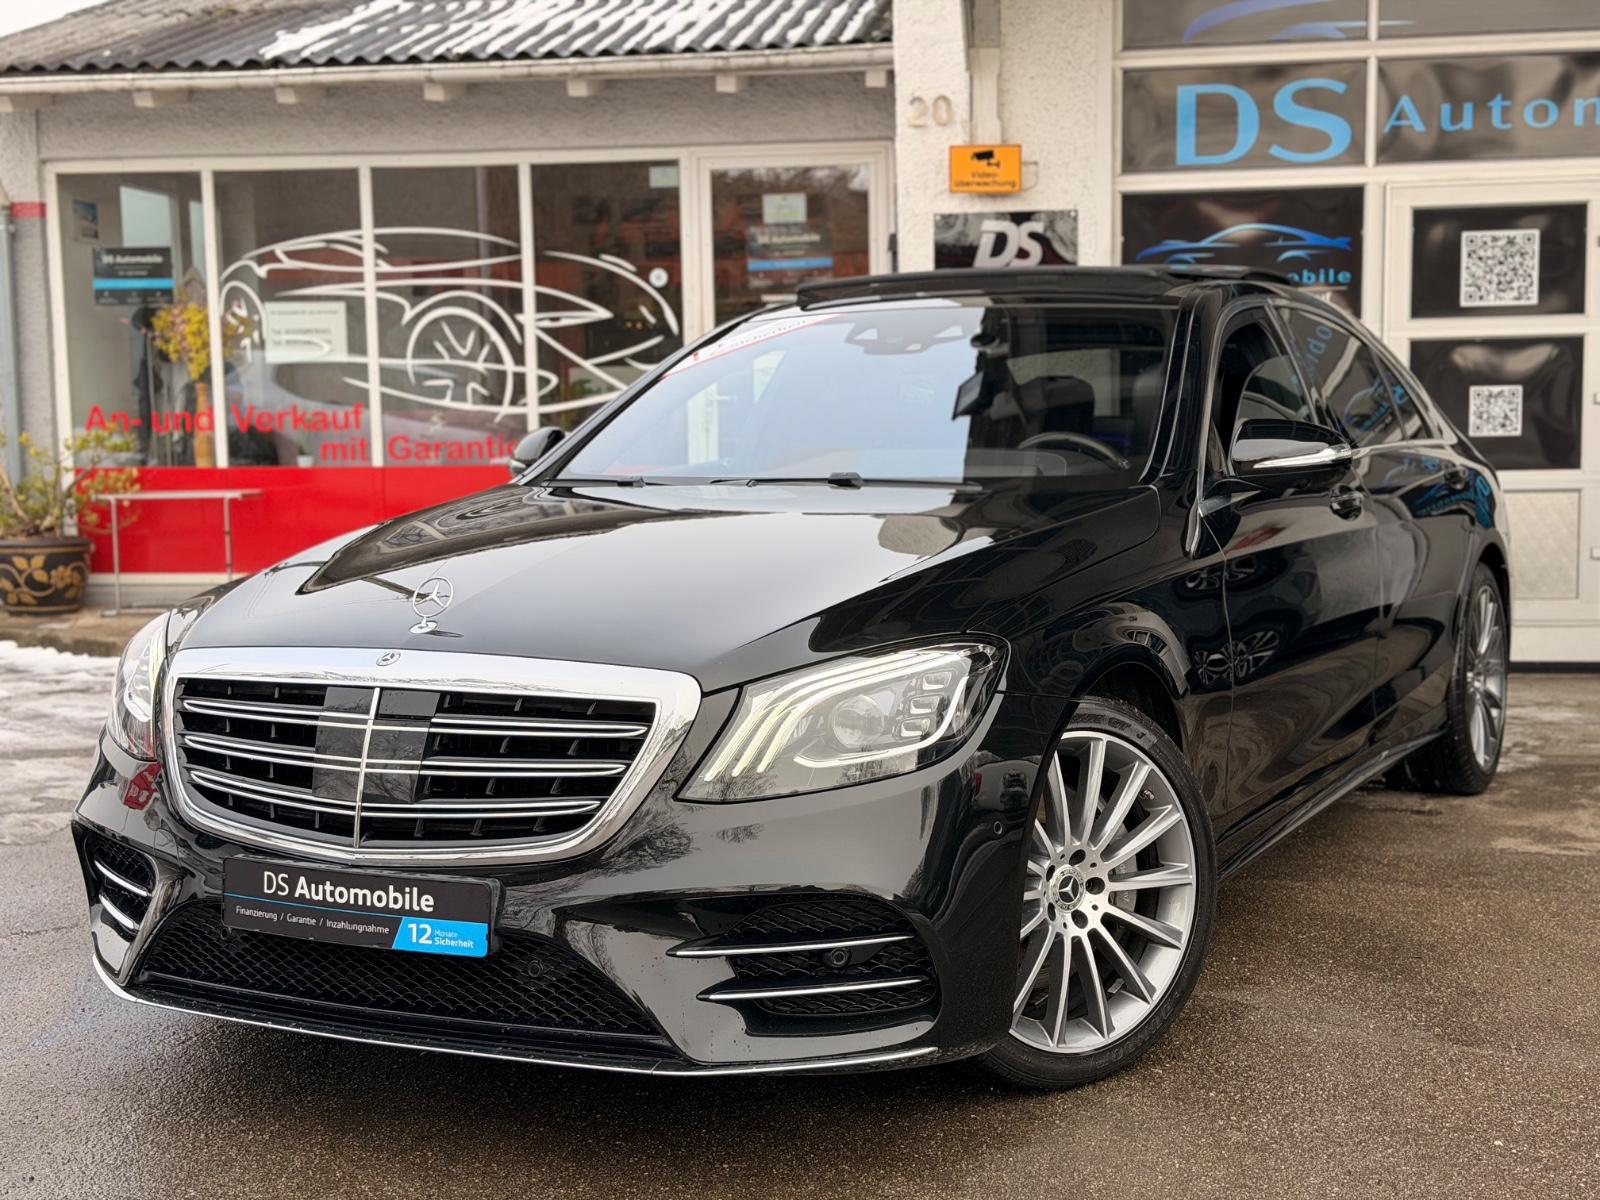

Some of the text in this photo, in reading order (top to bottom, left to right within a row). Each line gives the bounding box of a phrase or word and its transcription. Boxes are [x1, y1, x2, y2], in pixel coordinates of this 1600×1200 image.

[909, 95, 952, 128] 20
[1174, 78, 1353, 166] DS
[972, 219, 1046, 268] DS
[85, 402, 365, 433] An- und Verkauf
[320, 436, 369, 462] mit
[263, 870, 435, 913] DS Automobile
[235, 905, 278, 922] Finanzierung
[286, 913, 317, 926] Garantie
[326, 918, 390, 935] Inzahlungnahme
[408, 923, 433, 945] 12
[434, 929, 458, 938] Monate
[434, 937, 475, 949] Sicherheit
